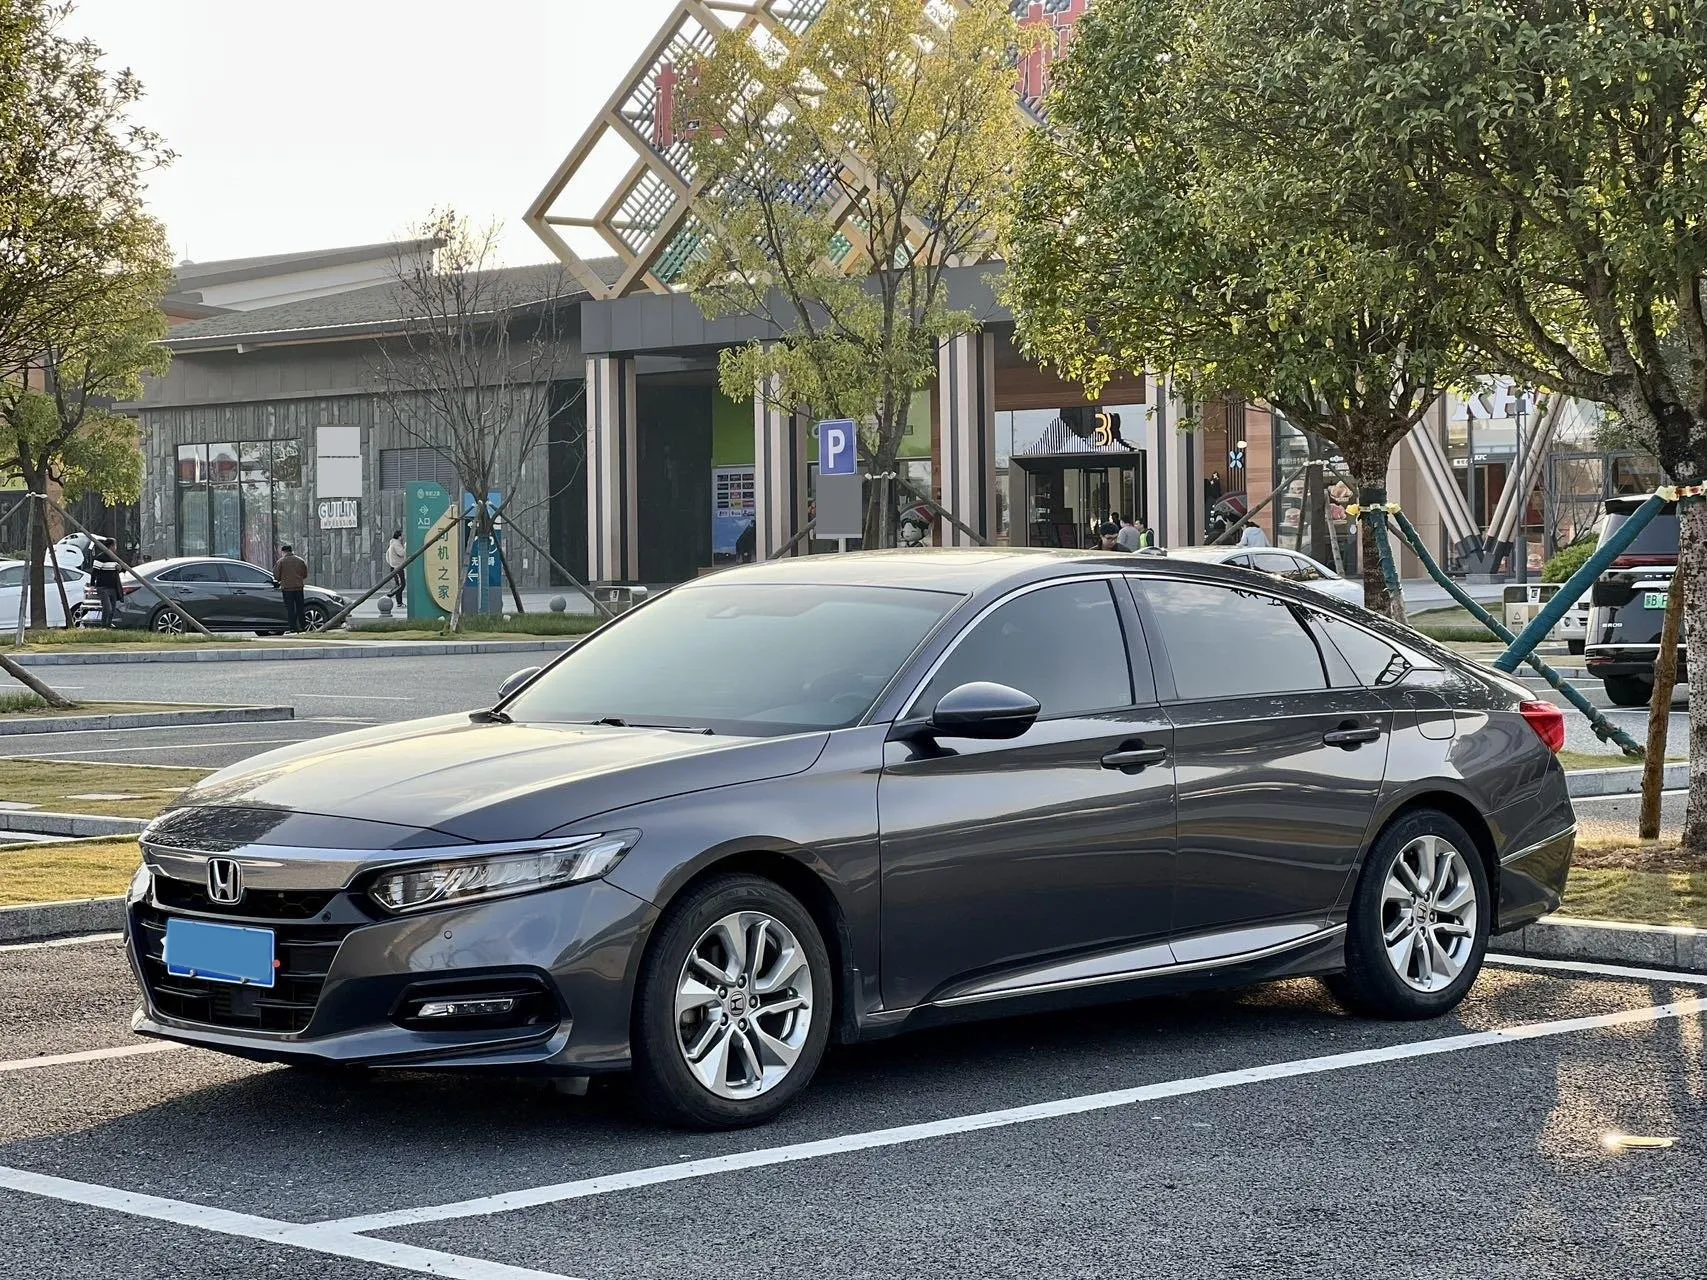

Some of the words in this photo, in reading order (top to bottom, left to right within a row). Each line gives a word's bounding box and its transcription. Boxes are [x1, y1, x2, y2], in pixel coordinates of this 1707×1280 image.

[827, 429, 846, 469] P
[318, 500, 358, 520] GUILIN
[417, 517, 431, 526] 入口
